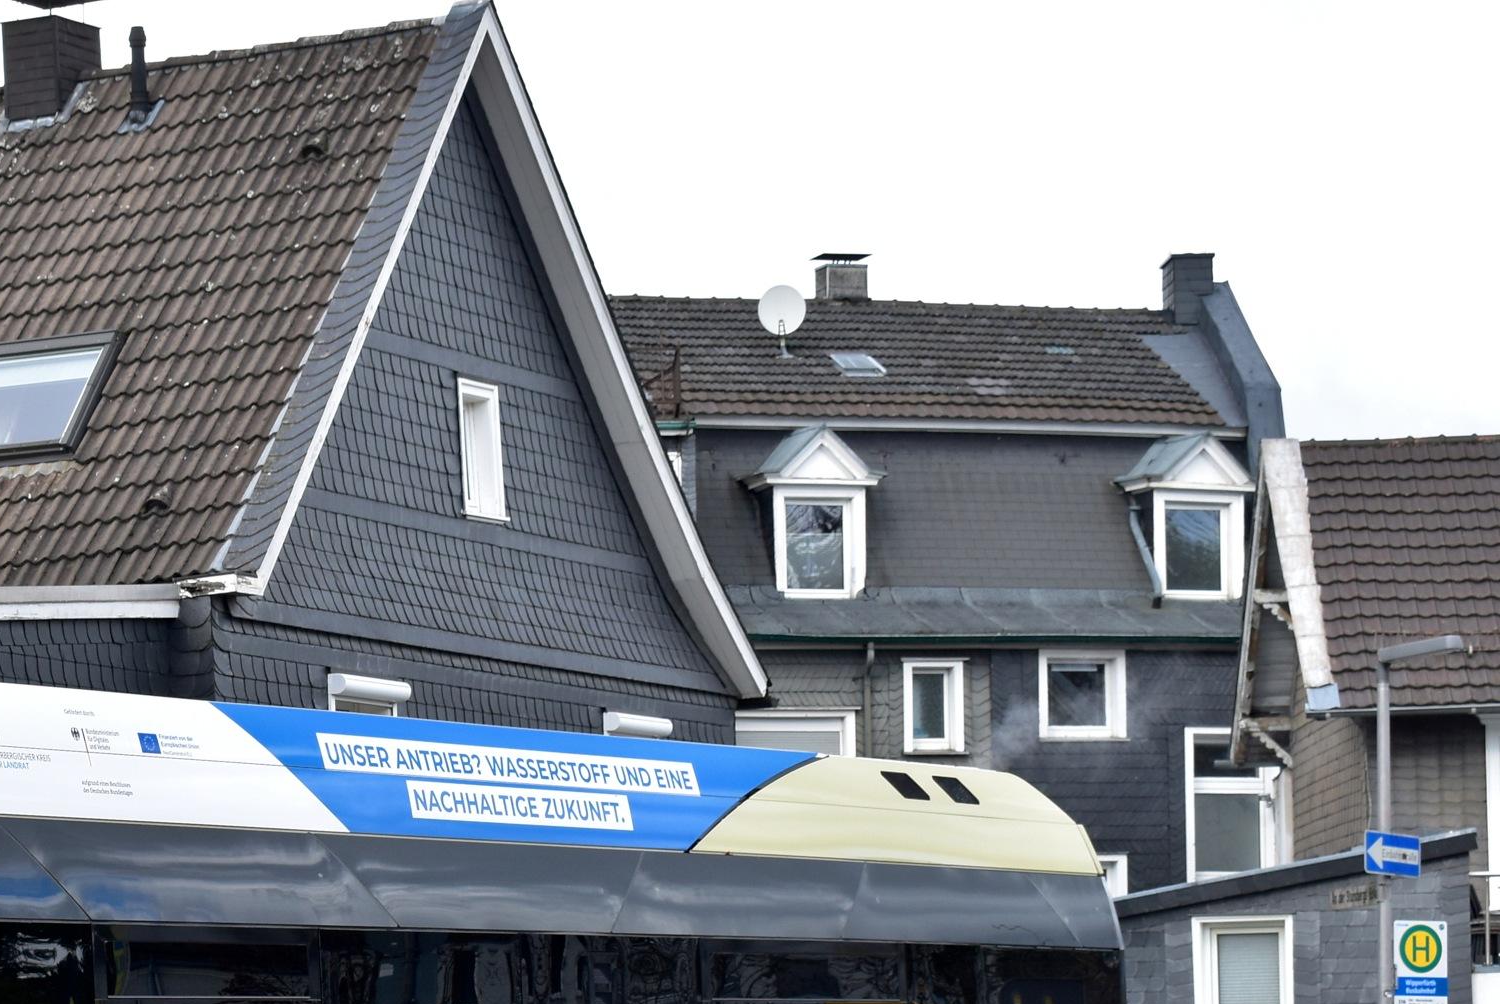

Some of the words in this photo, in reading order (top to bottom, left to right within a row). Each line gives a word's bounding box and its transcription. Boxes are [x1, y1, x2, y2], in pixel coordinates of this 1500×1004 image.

[3, 761, 30, 769] LANDRAT
[36, 754, 52, 762] KREIS
[325, 742, 391, 769] UNSER
[396, 748, 482, 775] ANTRIEB?
[485, 755, 610, 784] WASSERSTOFF
[613, 765, 651, 788] UND
[654, 768, 693, 790] EINE
[413, 788, 539, 819] NACHHALTIGE
[542, 797, 626, 824] ZUKUNFT.
[1412, 935, 1430, 962] H
